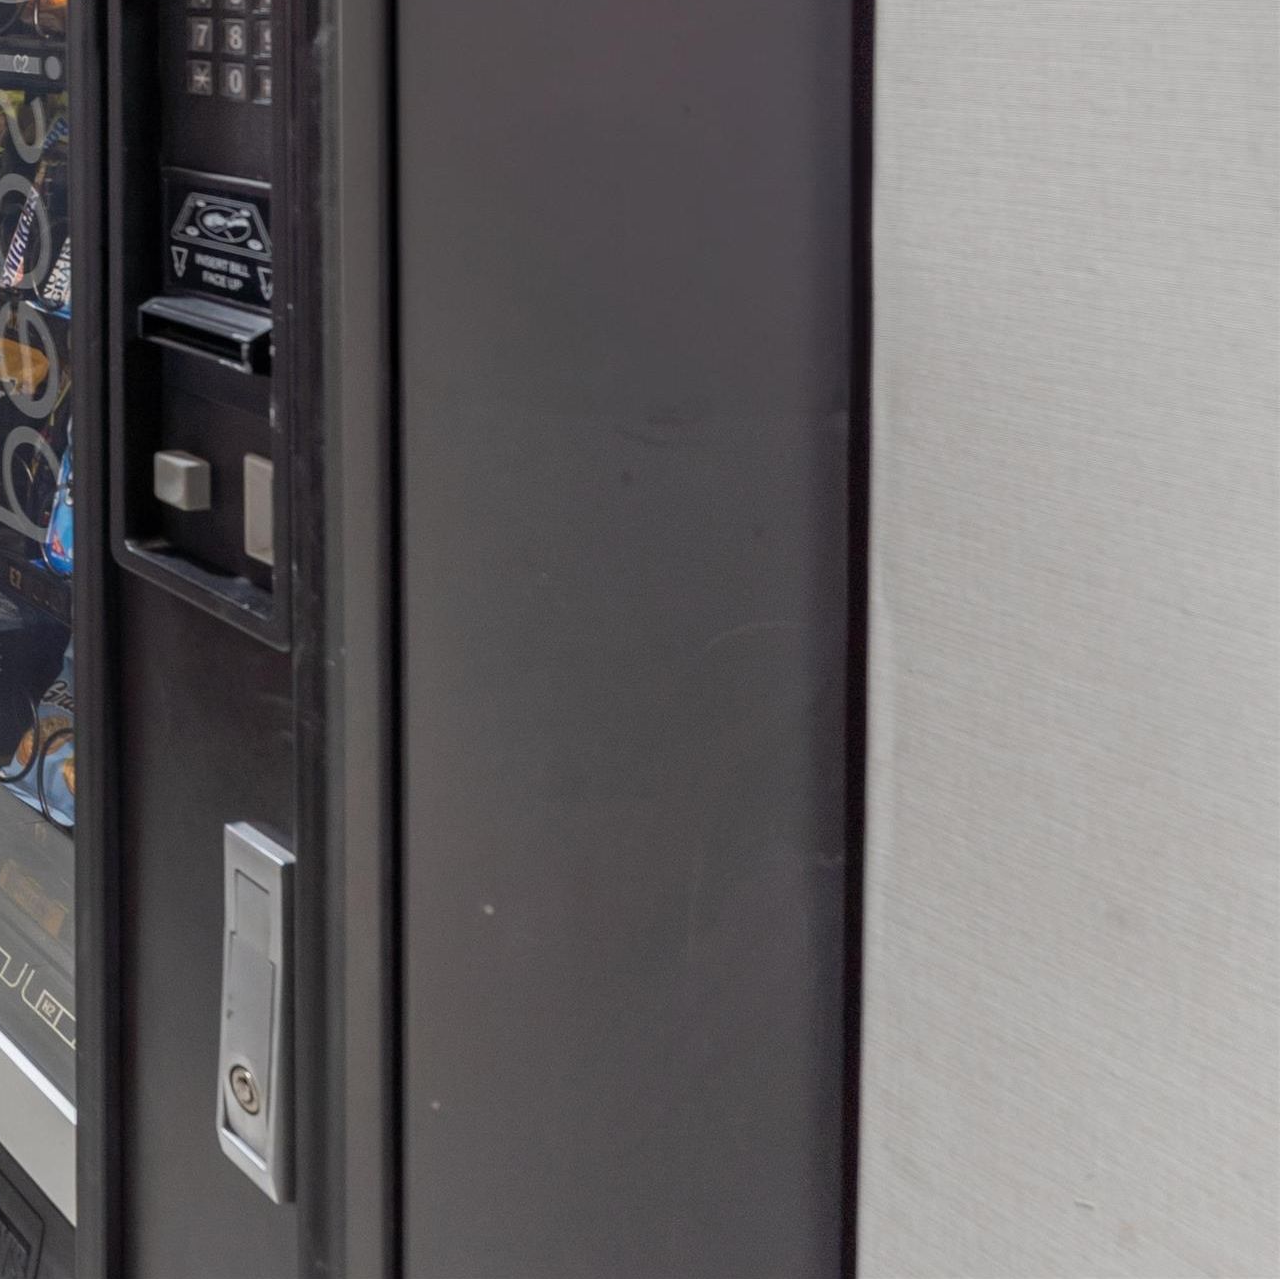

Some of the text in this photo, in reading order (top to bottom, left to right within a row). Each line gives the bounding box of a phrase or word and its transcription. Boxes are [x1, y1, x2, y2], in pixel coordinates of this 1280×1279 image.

[197, 25, 242, 49] 7 8
[194, 253, 251, 278] INSERT BILL
[201, 270, 244, 291] FACE UP
